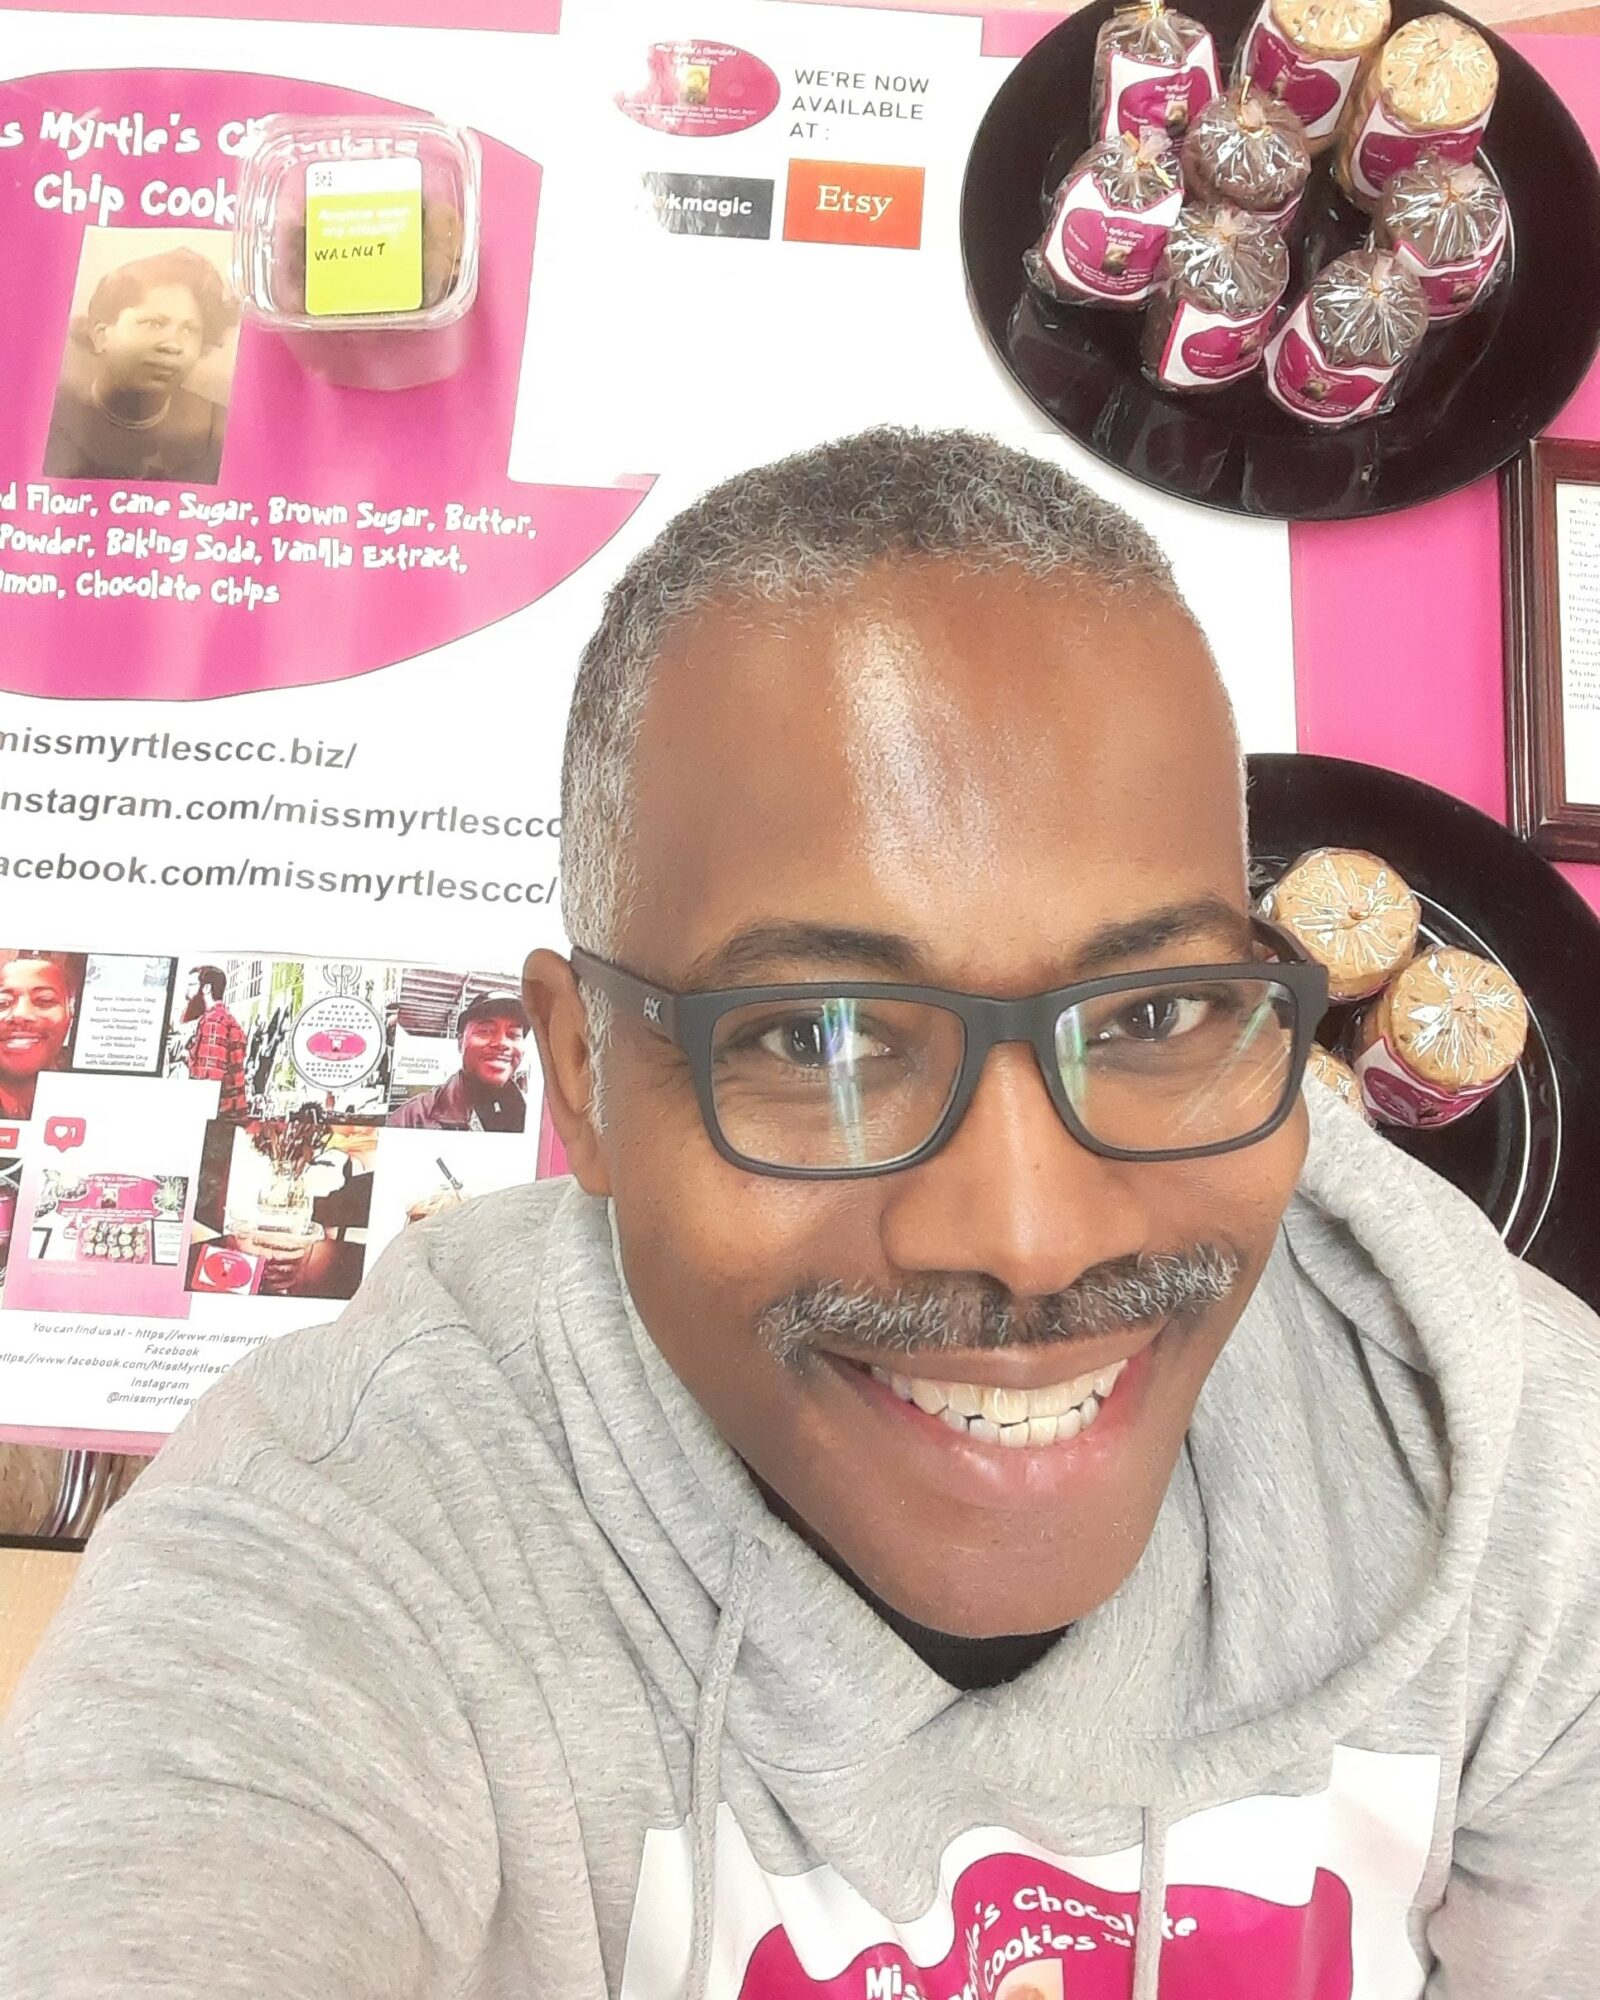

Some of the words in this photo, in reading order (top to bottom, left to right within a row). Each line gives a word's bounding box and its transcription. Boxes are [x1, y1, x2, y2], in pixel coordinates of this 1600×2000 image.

[794, 69, 866, 90] WE'RE
[874, 75, 930, 94] NOW
[791, 96, 925, 121] AVAILABLE
[39, 110, 201, 162] Myrtle's
[789, 122, 818, 139] AT
[33, 170, 125, 228] Chip
[140, 176, 239, 226] Cook
[815, 184, 893, 222] Etsy
[314, 242, 386, 262] WALNUT
[26, 483, 98, 517] Flour,
[109, 491, 171, 517] Cane
[178, 491, 259, 528] Sugar,
[268, 496, 348, 526] Brown
[356, 502, 436, 535] Sugar,
[445, 503, 537, 540] Butter,
[106, 527, 189, 564] Baking
[194, 533, 263, 566] Soda,
[362, 544, 468, 574] Extract,
[0, 569, 66, 600] mon,
[75, 569, 202, 602] Chocolate
[210, 577, 281, 612] Chips
[145, 1344, 200, 1357] Facebook
[131, 1377, 190, 1391] Instagram
[865, 1964, 927, 2000] Mis
[1013, 1886, 1198, 1940] Chocolte
